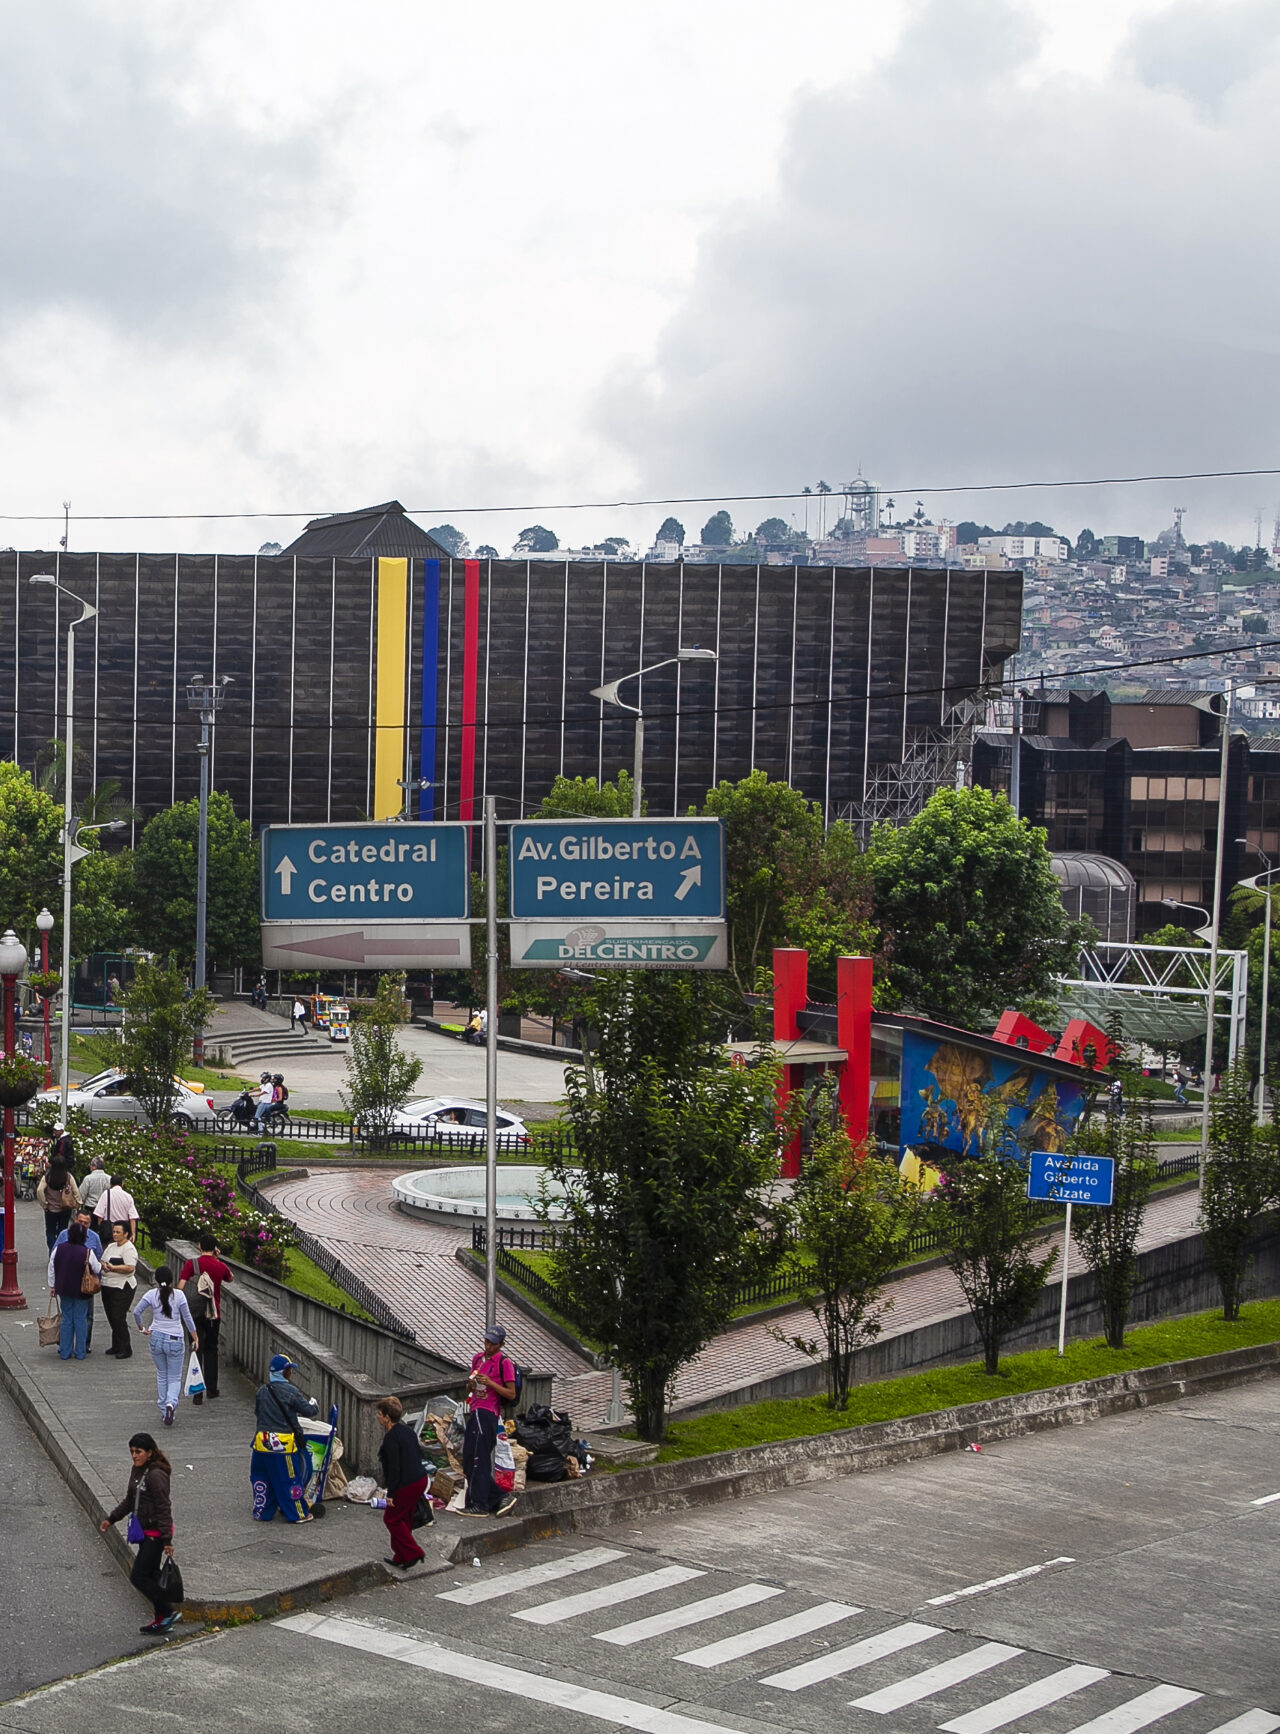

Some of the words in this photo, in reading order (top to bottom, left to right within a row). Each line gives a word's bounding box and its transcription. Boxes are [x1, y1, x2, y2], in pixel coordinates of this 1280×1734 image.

[308, 838, 436, 863] Catedral
[308, 879, 414, 903] Centro
[537, 876, 654, 900] Pereira
[574, 961, 610, 969] Centro
[612, 961, 627, 969] de
[1044, 1157, 1099, 1171] Avenida
